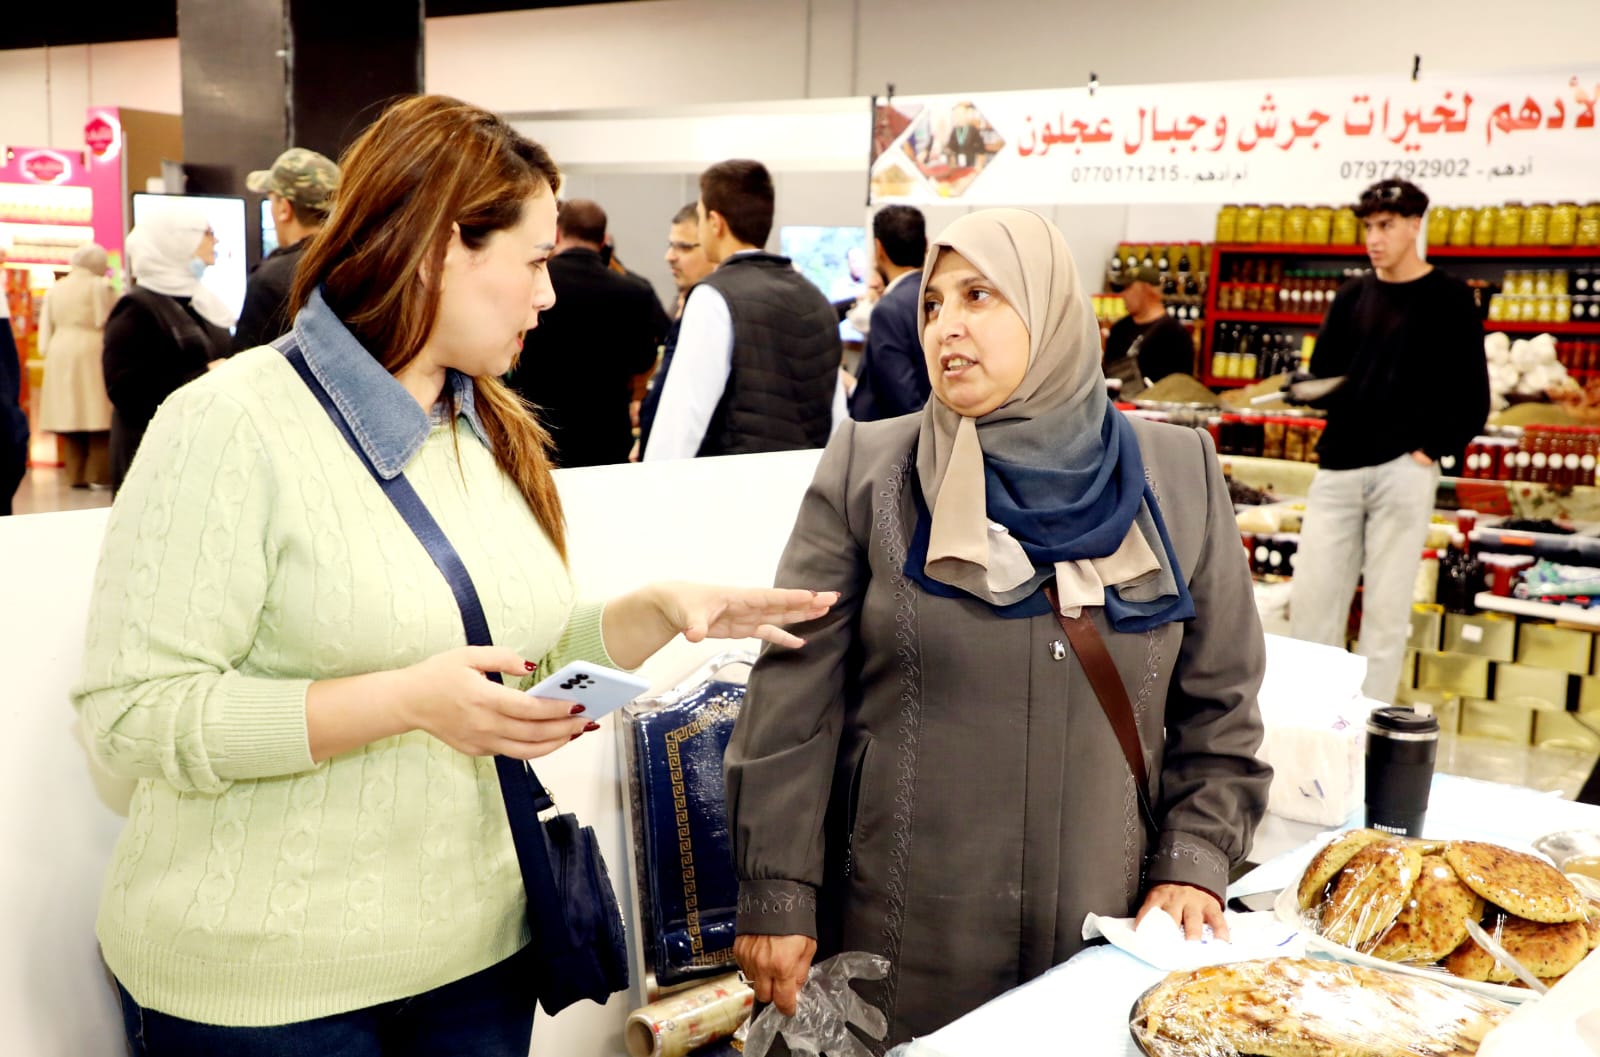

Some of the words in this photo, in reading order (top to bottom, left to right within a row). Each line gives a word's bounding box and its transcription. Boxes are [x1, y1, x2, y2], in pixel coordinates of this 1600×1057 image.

[1017, 110, 1114, 157] عجلون
[1123, 105, 1228, 156] وجبال
[1236, 93, 1331, 152] جرش
[1343, 91, 1473, 152] لخيرات
[1071, 164, 1180, 183] 0770171215
[1340, 158, 1471, 180] 0797292902
[1373, 823, 1407, 835] SAMSUNG
